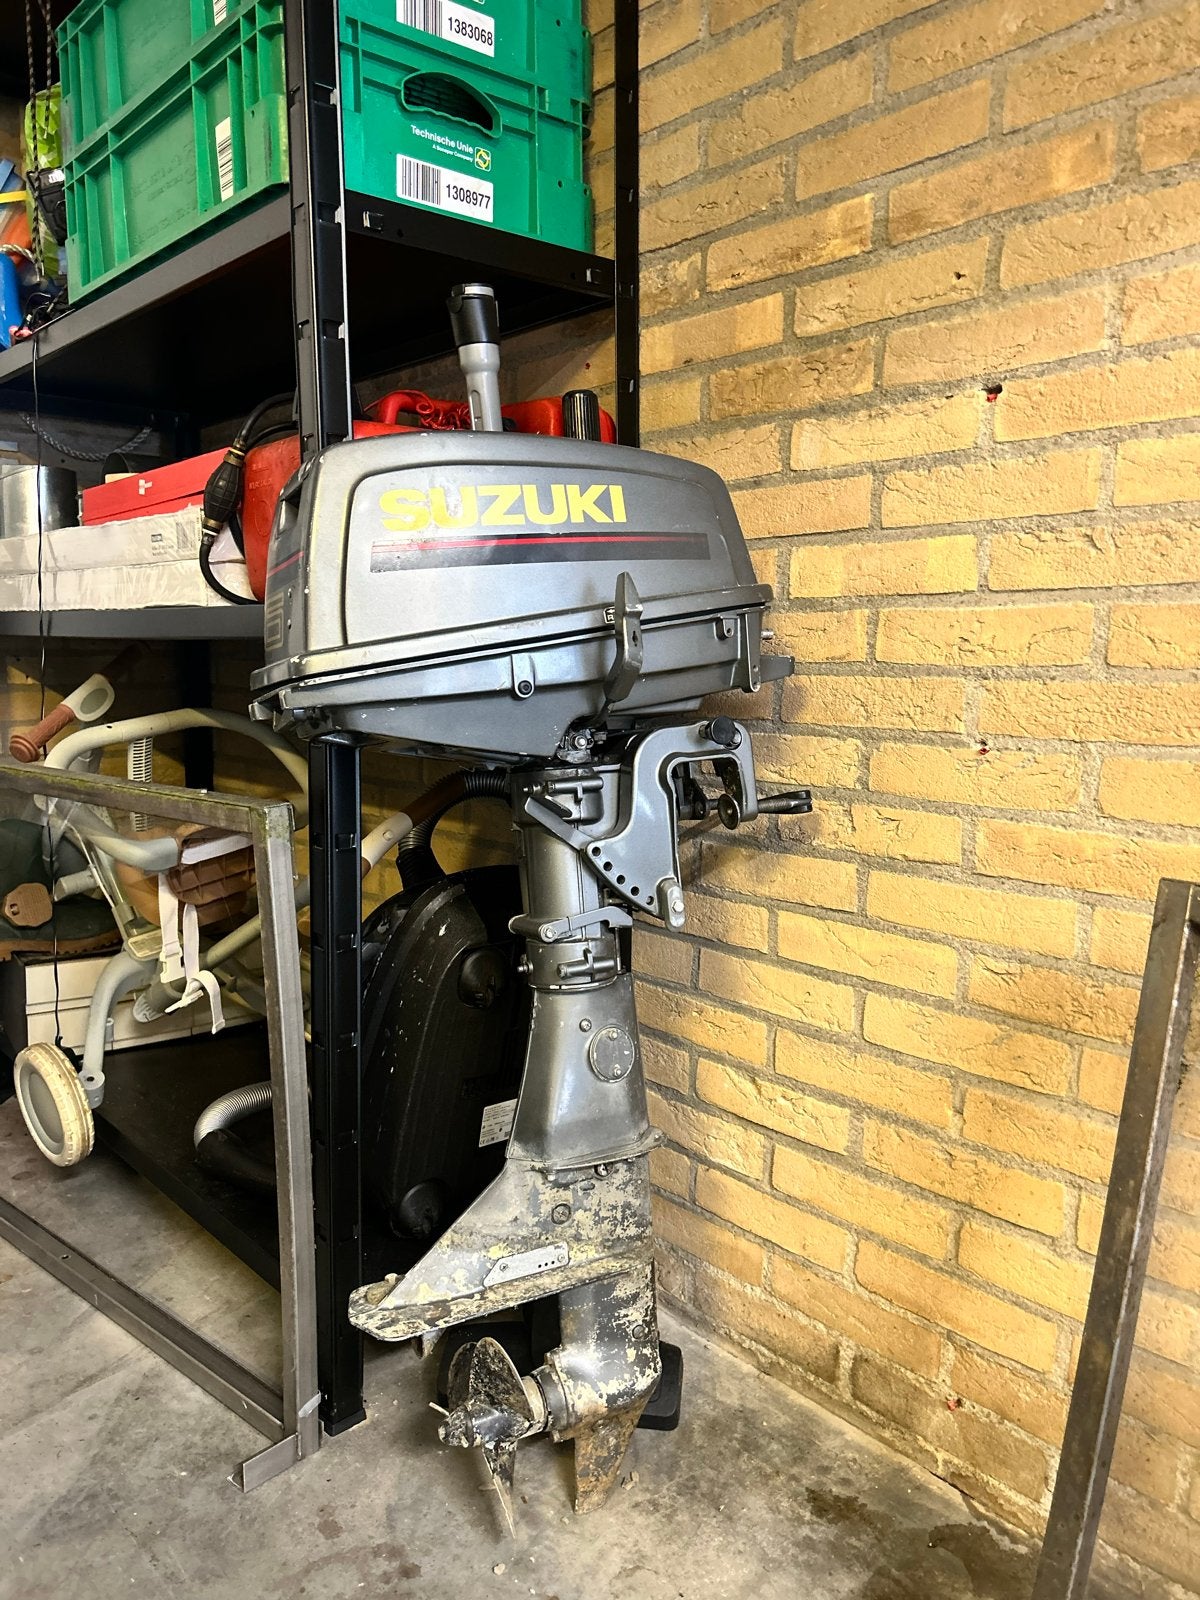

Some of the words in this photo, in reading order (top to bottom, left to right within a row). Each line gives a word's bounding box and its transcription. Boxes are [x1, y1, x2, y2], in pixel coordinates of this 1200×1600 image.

[448, 16, 493, 46] 1383068
[410, 124, 456, 148] Technische
[456, 140, 474, 154] Unie
[446, 184, 491, 209] 1308977
[379, 484, 627, 532] SUZUKI
